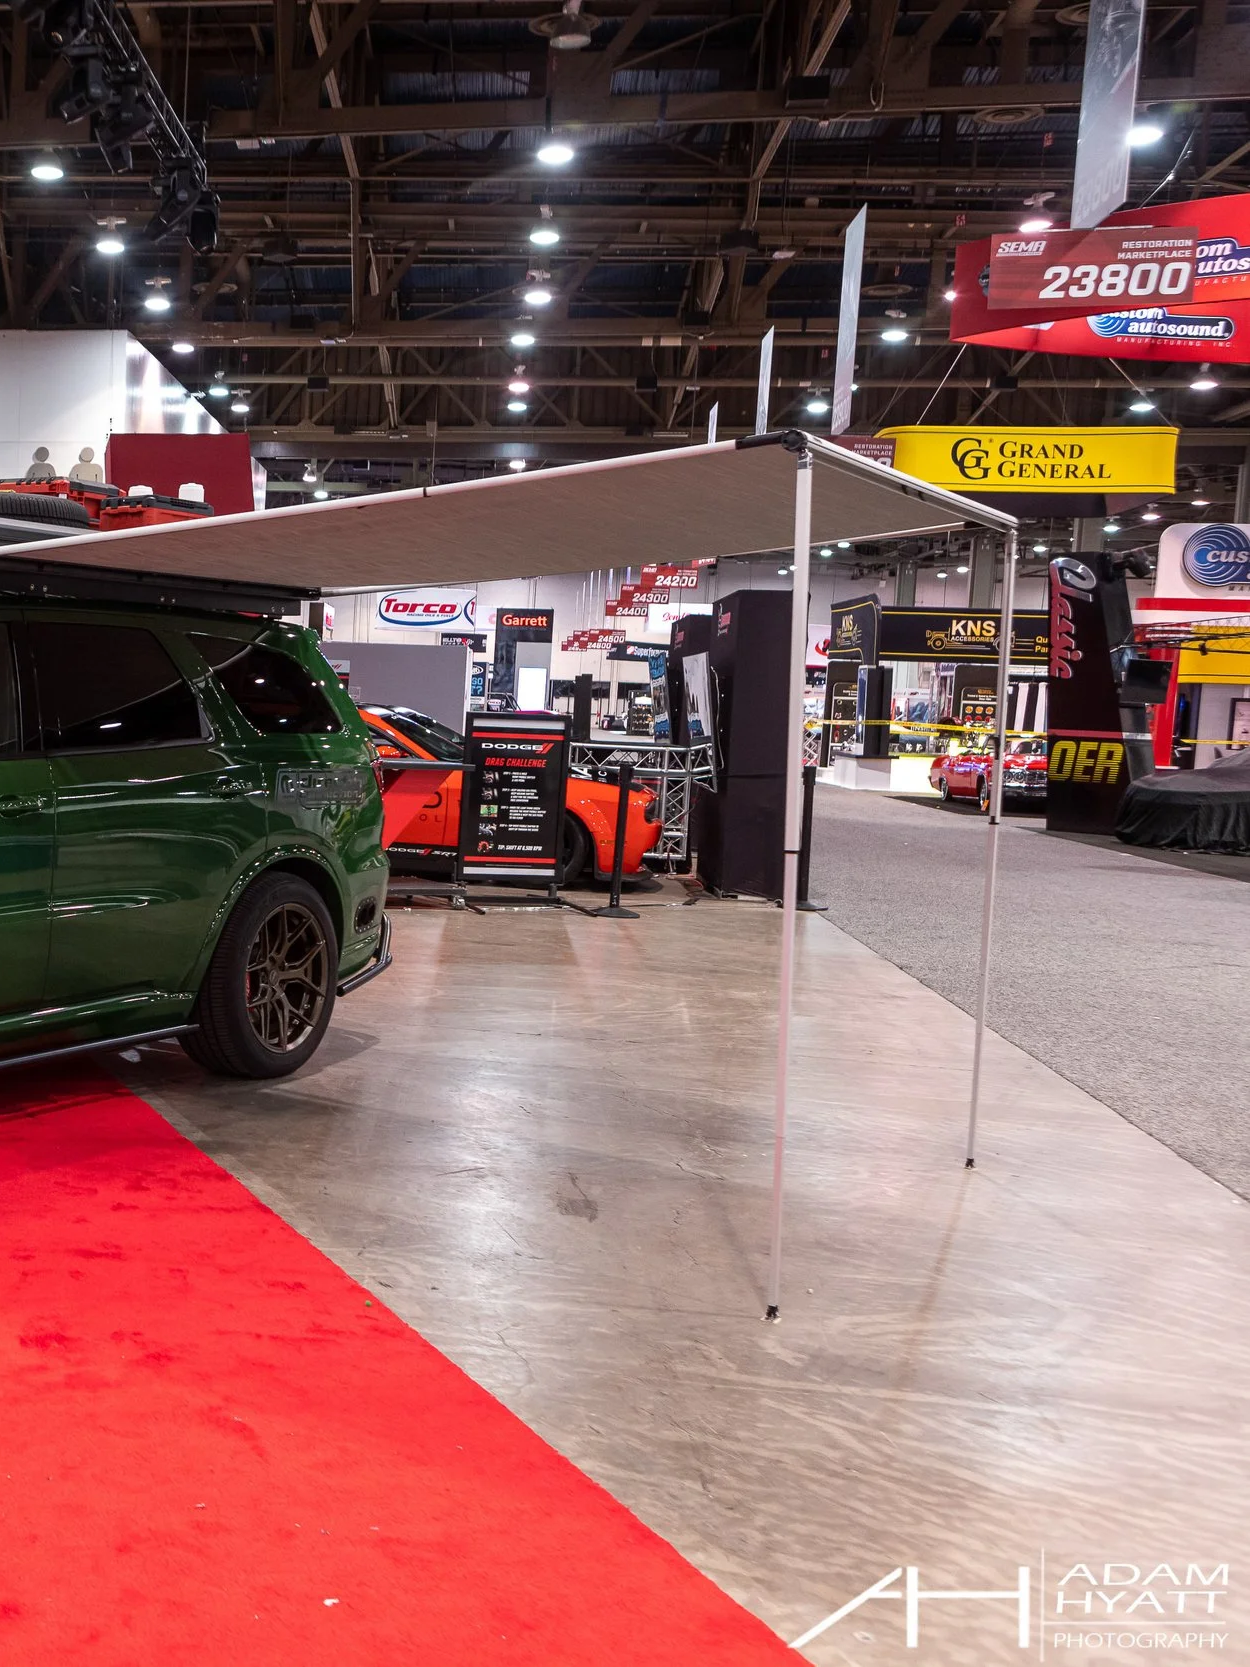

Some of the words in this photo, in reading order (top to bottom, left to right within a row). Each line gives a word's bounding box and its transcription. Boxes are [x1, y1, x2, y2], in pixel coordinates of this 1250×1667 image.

[998, 240, 1047, 253] SEMA
[1122, 239, 1192, 249] RESTORATION
[1117, 250, 1192, 260] MARKETPLACE
[1038, 261, 1191, 299] 23800
[999, 441, 1084, 459] GRAND
[997, 460, 1112, 479] GENERAL
[1206, 550, 1250, 563] cus
[655, 575, 697, 587] 24200
[632, 592, 669, 603] 24300
[385, 598, 458, 614] Torco
[616, 607, 648, 616] 24400
[502, 614, 548, 627] Garrett
[951, 619, 996, 637] KNS
[481, 743, 543, 751] DODGE
[485, 757, 505, 766] DRAG
[506, 758, 547, 767] CHALLENGE
[1049, 740, 1125, 784] OER
